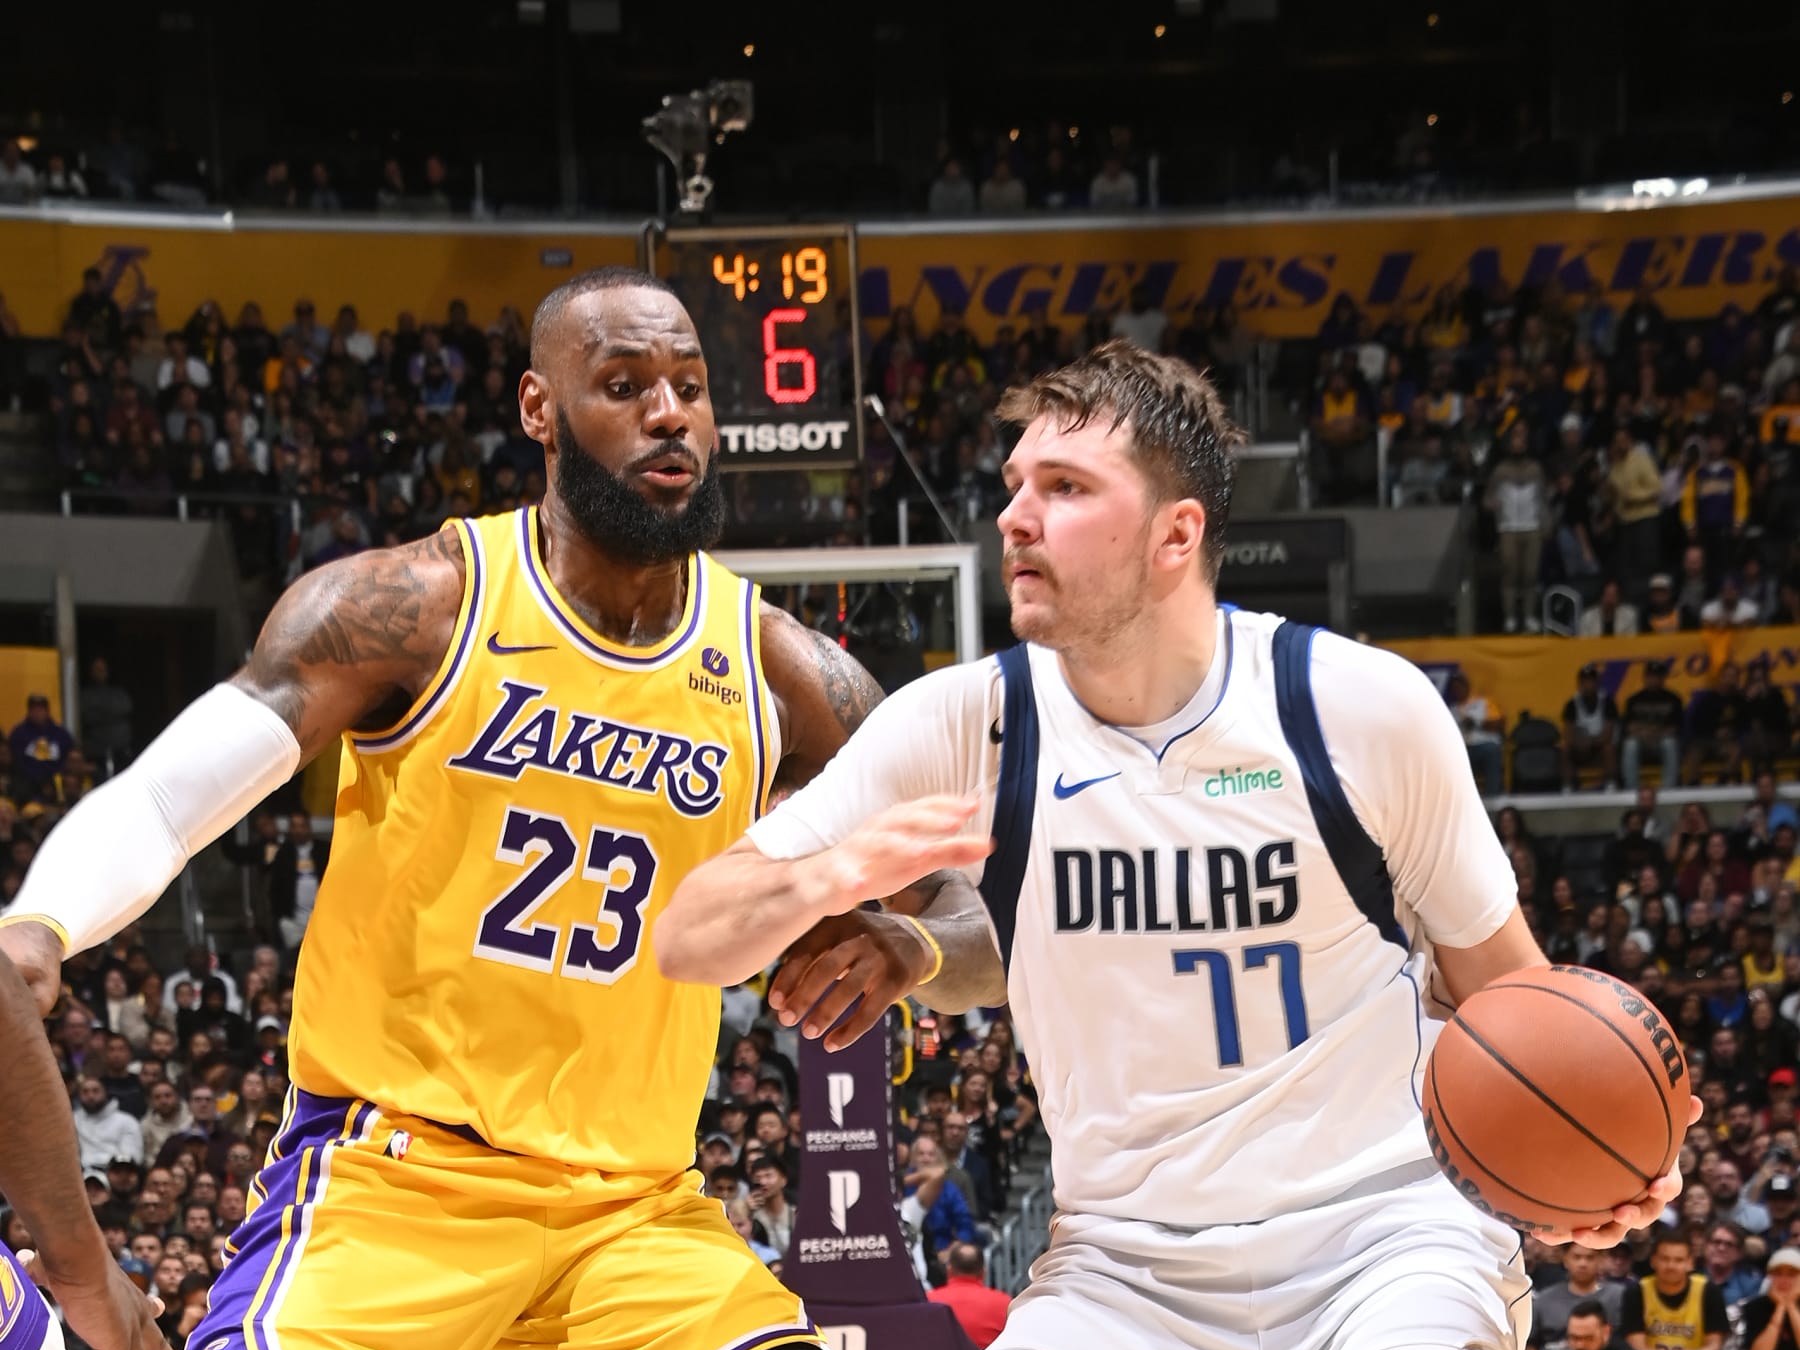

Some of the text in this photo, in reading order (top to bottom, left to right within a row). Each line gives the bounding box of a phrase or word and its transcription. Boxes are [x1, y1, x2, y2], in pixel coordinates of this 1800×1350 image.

[713, 247, 828, 304] 4:19
[763, 307, 816, 403] 6
[720, 421, 850, 453] TISSOT
[688, 672, 742, 706] bibigo
[444, 675, 732, 818] LAKERS
[1204, 767, 1284, 798] chime
[472, 804, 660, 986] 23
[1050, 837, 1301, 936] DALLAS
[1171, 939, 1311, 1070] 77
[806, 1129, 878, 1145] PECHANGA
[807, 1143, 878, 1152] RESORT CASINO
[800, 1235, 889, 1253] PECHANGA
[800, 1250, 890, 1263] RESORT CASINO
